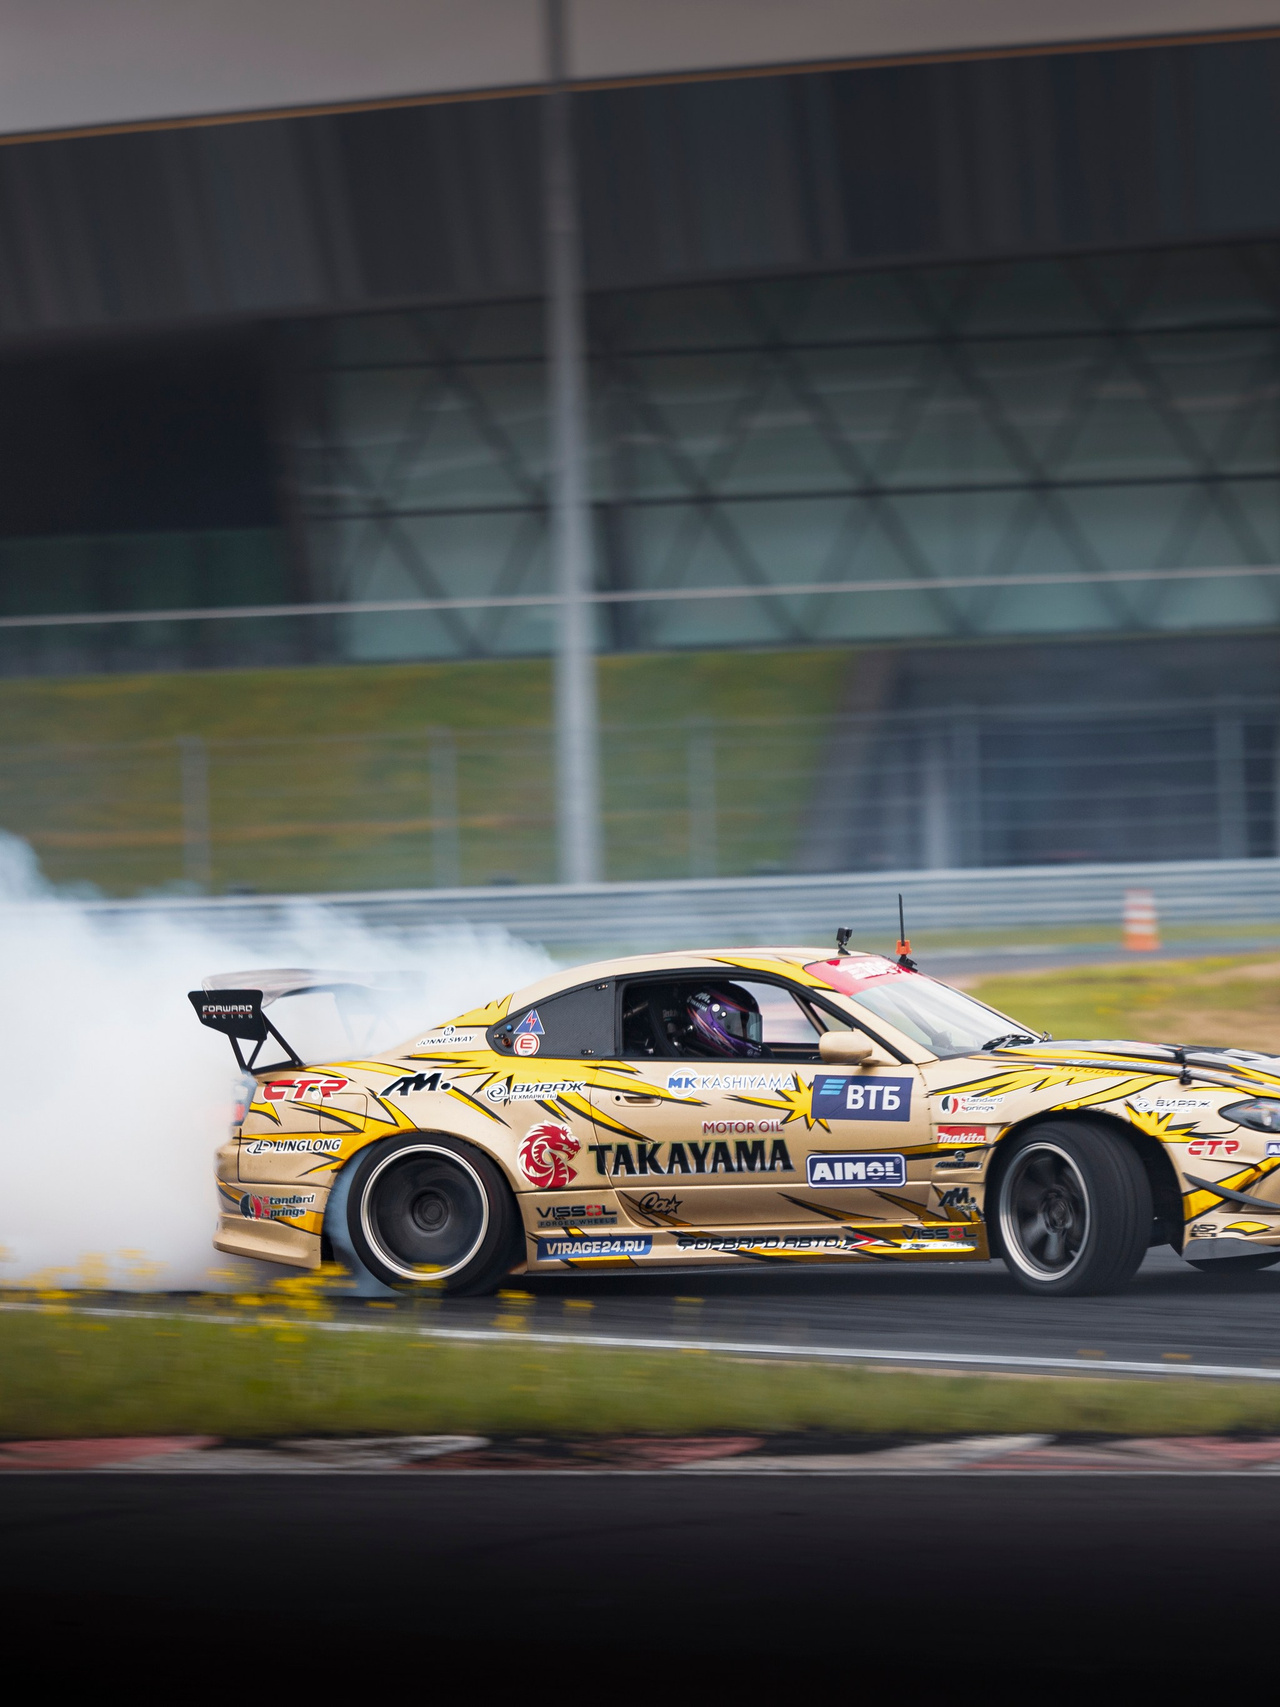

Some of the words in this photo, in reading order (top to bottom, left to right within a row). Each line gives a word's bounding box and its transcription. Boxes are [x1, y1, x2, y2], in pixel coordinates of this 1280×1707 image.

[417, 1036, 475, 1046] JONNESWAY
[520, 1038, 534, 1049] E
[512, 1082, 585, 1093] ВИРАЖ
[701, 1077, 794, 1089] KASHIYAMA
[846, 1084, 901, 1110] ВТБ
[704, 1121, 755, 1133] MOTOR
[758, 1120, 785, 1132] OIL
[276, 1139, 342, 1152] LINGLONG
[589, 1141, 794, 1177] TAKAYAMA
[812, 1161, 901, 1181] AIMOL
[263, 1195, 315, 1204] Standard
[264, 1207, 306, 1218] Springs
[537, 1205, 617, 1217] VISSOL
[579, 1217, 617, 1225] WHEELS
[902, 1227, 977, 1240] VISSOL
[546, 1240, 646, 1255] VIRAGE24.RU
